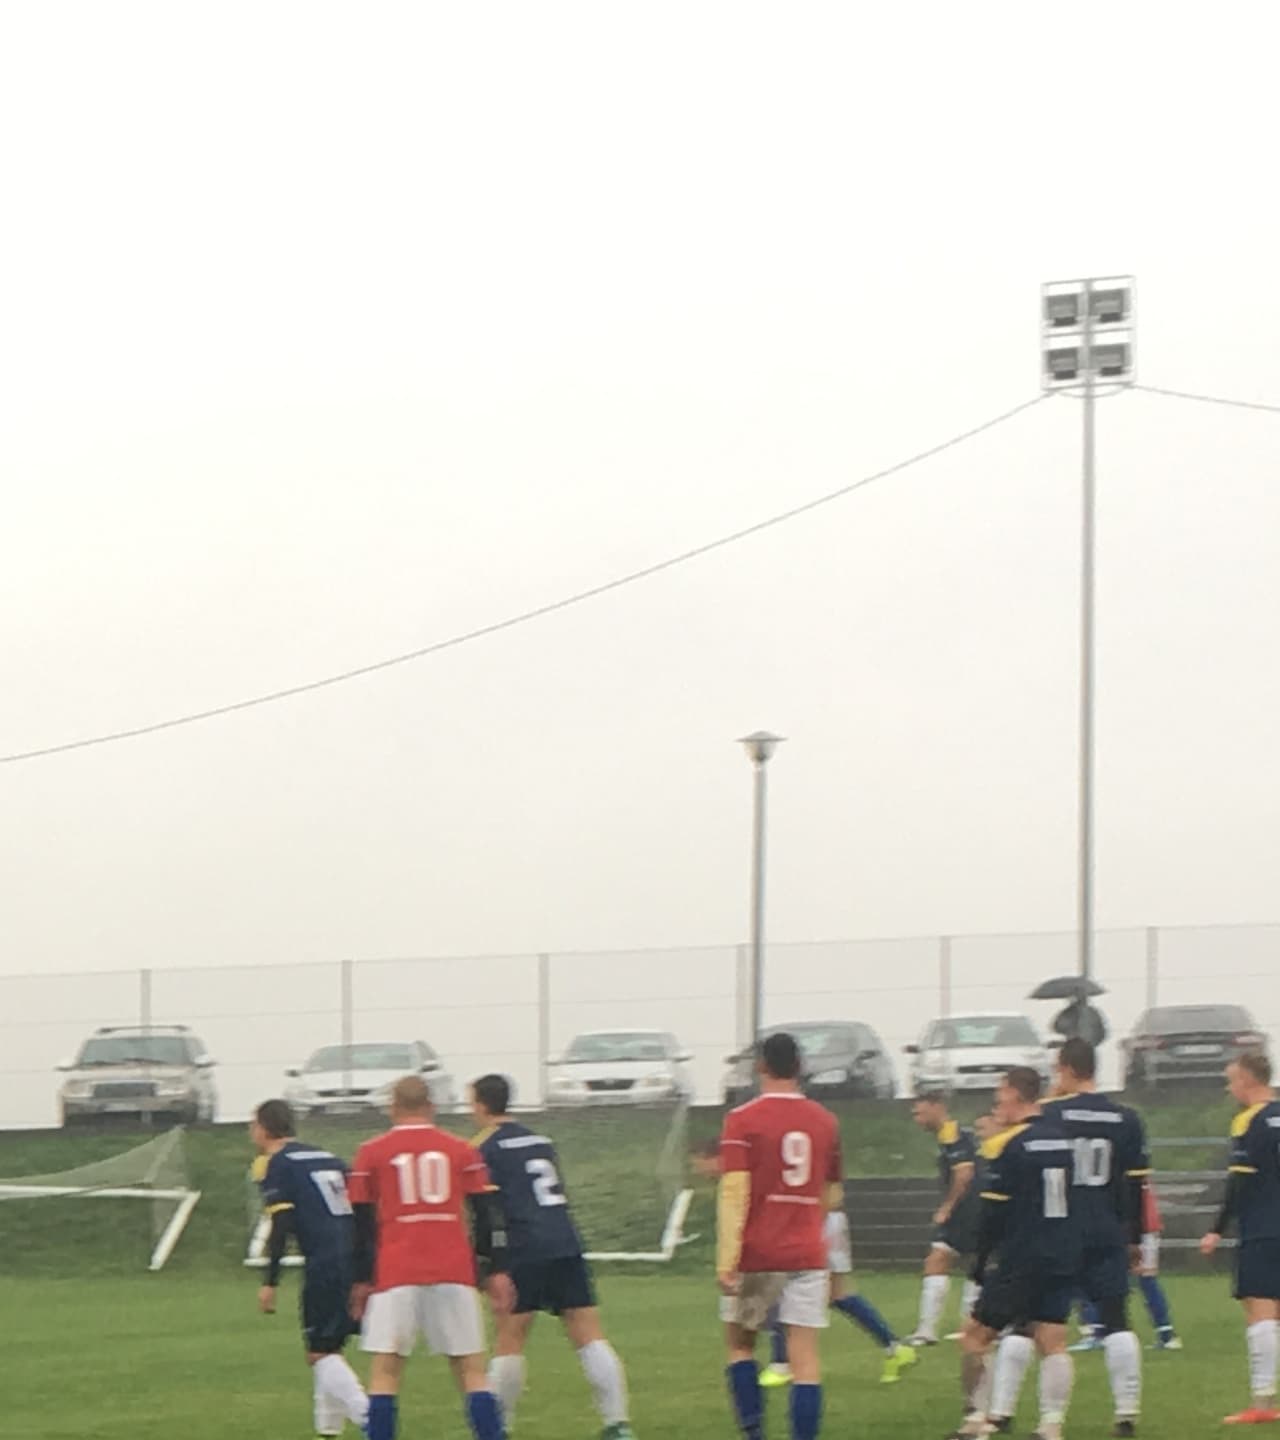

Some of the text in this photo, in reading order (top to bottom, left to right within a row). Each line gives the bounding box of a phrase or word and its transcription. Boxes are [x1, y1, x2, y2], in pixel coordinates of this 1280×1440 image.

[389, 1151, 451, 1205] 10
[525, 1158, 568, 1206] 2
[782, 1131, 811, 1187] 9
[1072, 1137, 1113, 1186] 10
